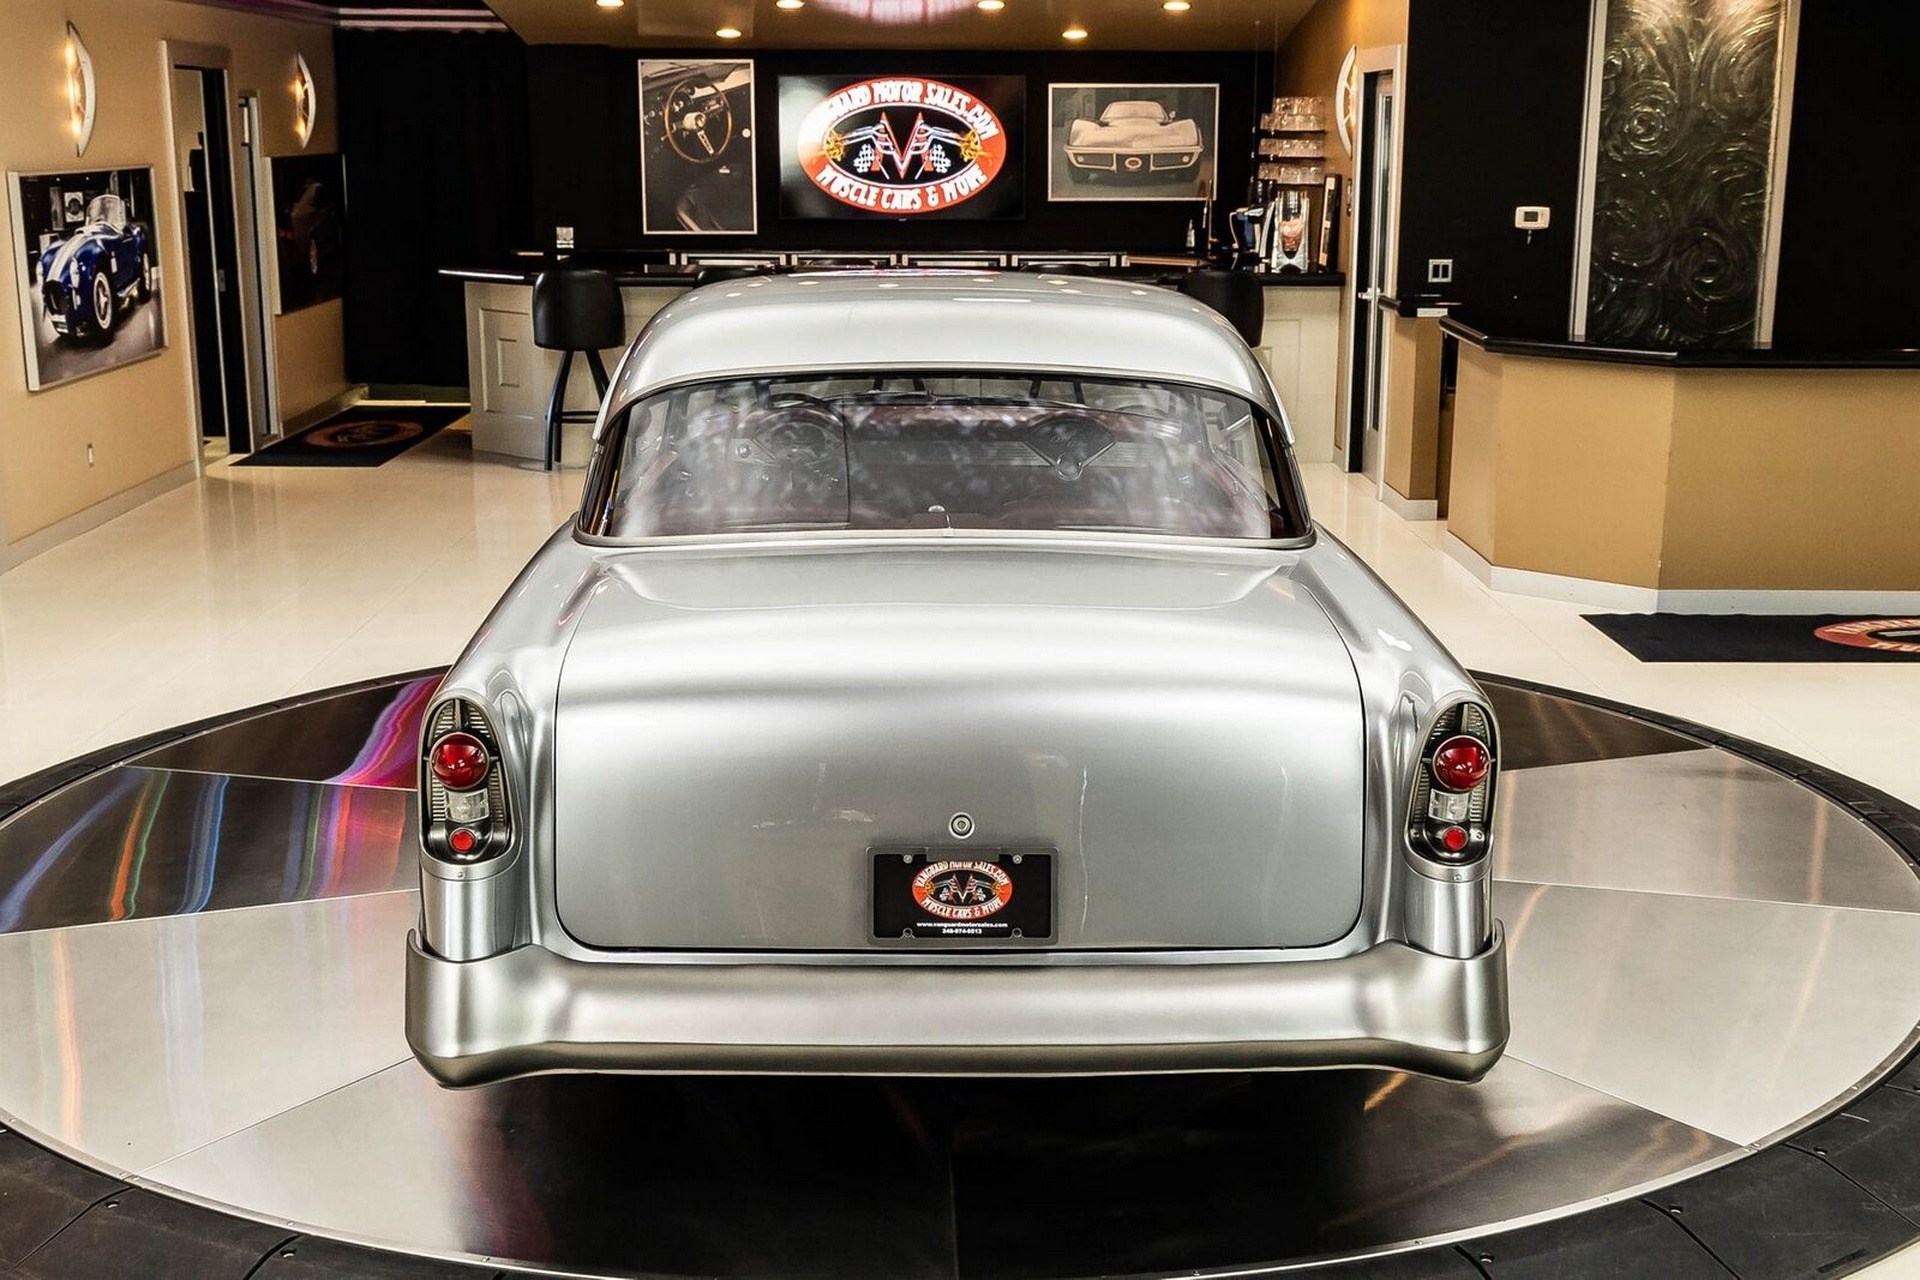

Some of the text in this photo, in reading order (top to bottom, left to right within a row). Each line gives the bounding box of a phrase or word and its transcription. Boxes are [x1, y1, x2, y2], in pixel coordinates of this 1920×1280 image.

[872, 80, 923, 104] MOTOR
[925, 82, 1000, 140] SALES.COM
[815, 163, 988, 210] MUSCLE CARS & MORE
[915, 861, 949, 887] VANGUARD
[973, 861, 1010, 885] SALES.COM
[921, 897, 1003, 918] MUSCLE CARS & MORE
